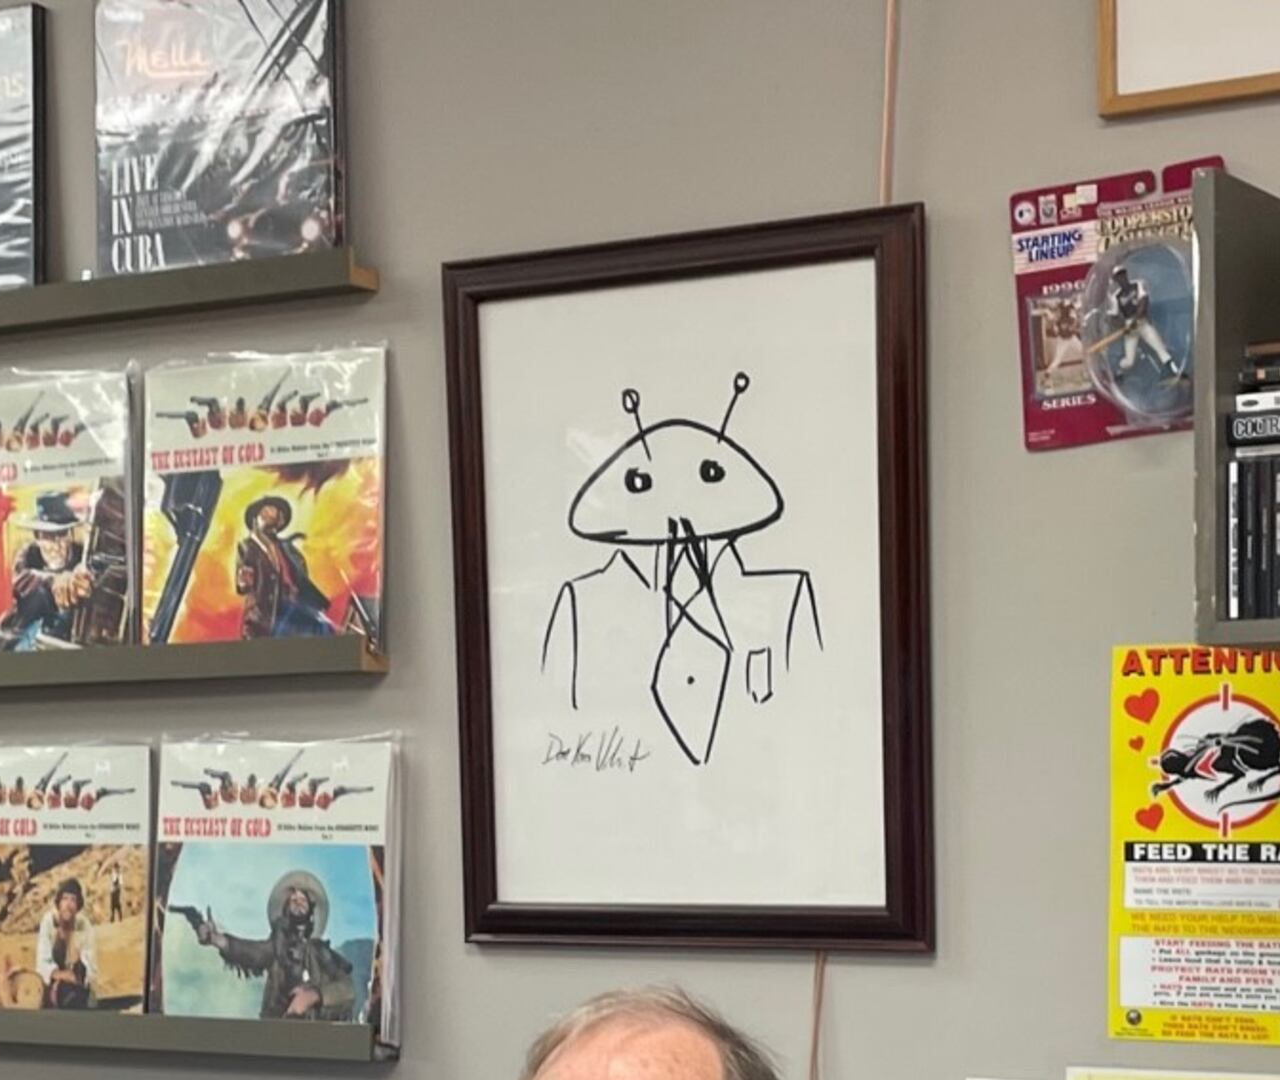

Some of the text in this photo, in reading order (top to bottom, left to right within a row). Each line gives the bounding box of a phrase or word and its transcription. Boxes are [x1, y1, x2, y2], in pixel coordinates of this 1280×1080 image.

[111, 155, 160, 196] LIVE
[111, 196, 134, 236] IN
[1096, 205, 1194, 236] COOPERSTO
[1017, 229, 1082, 251] STARTING
[111, 232, 167, 275] CUBA
[1028, 244, 1075, 263] LINEUP
[1041, 393, 1097, 411] SERIES
[151, 450, 170, 470] THE
[238, 442, 265, 464] GOLD
[163, 817, 181, 836] THE
[246, 818, 272, 838] GOLD
[1133, 844, 1192, 860] FEED
[1202, 844, 1249, 861] THE
